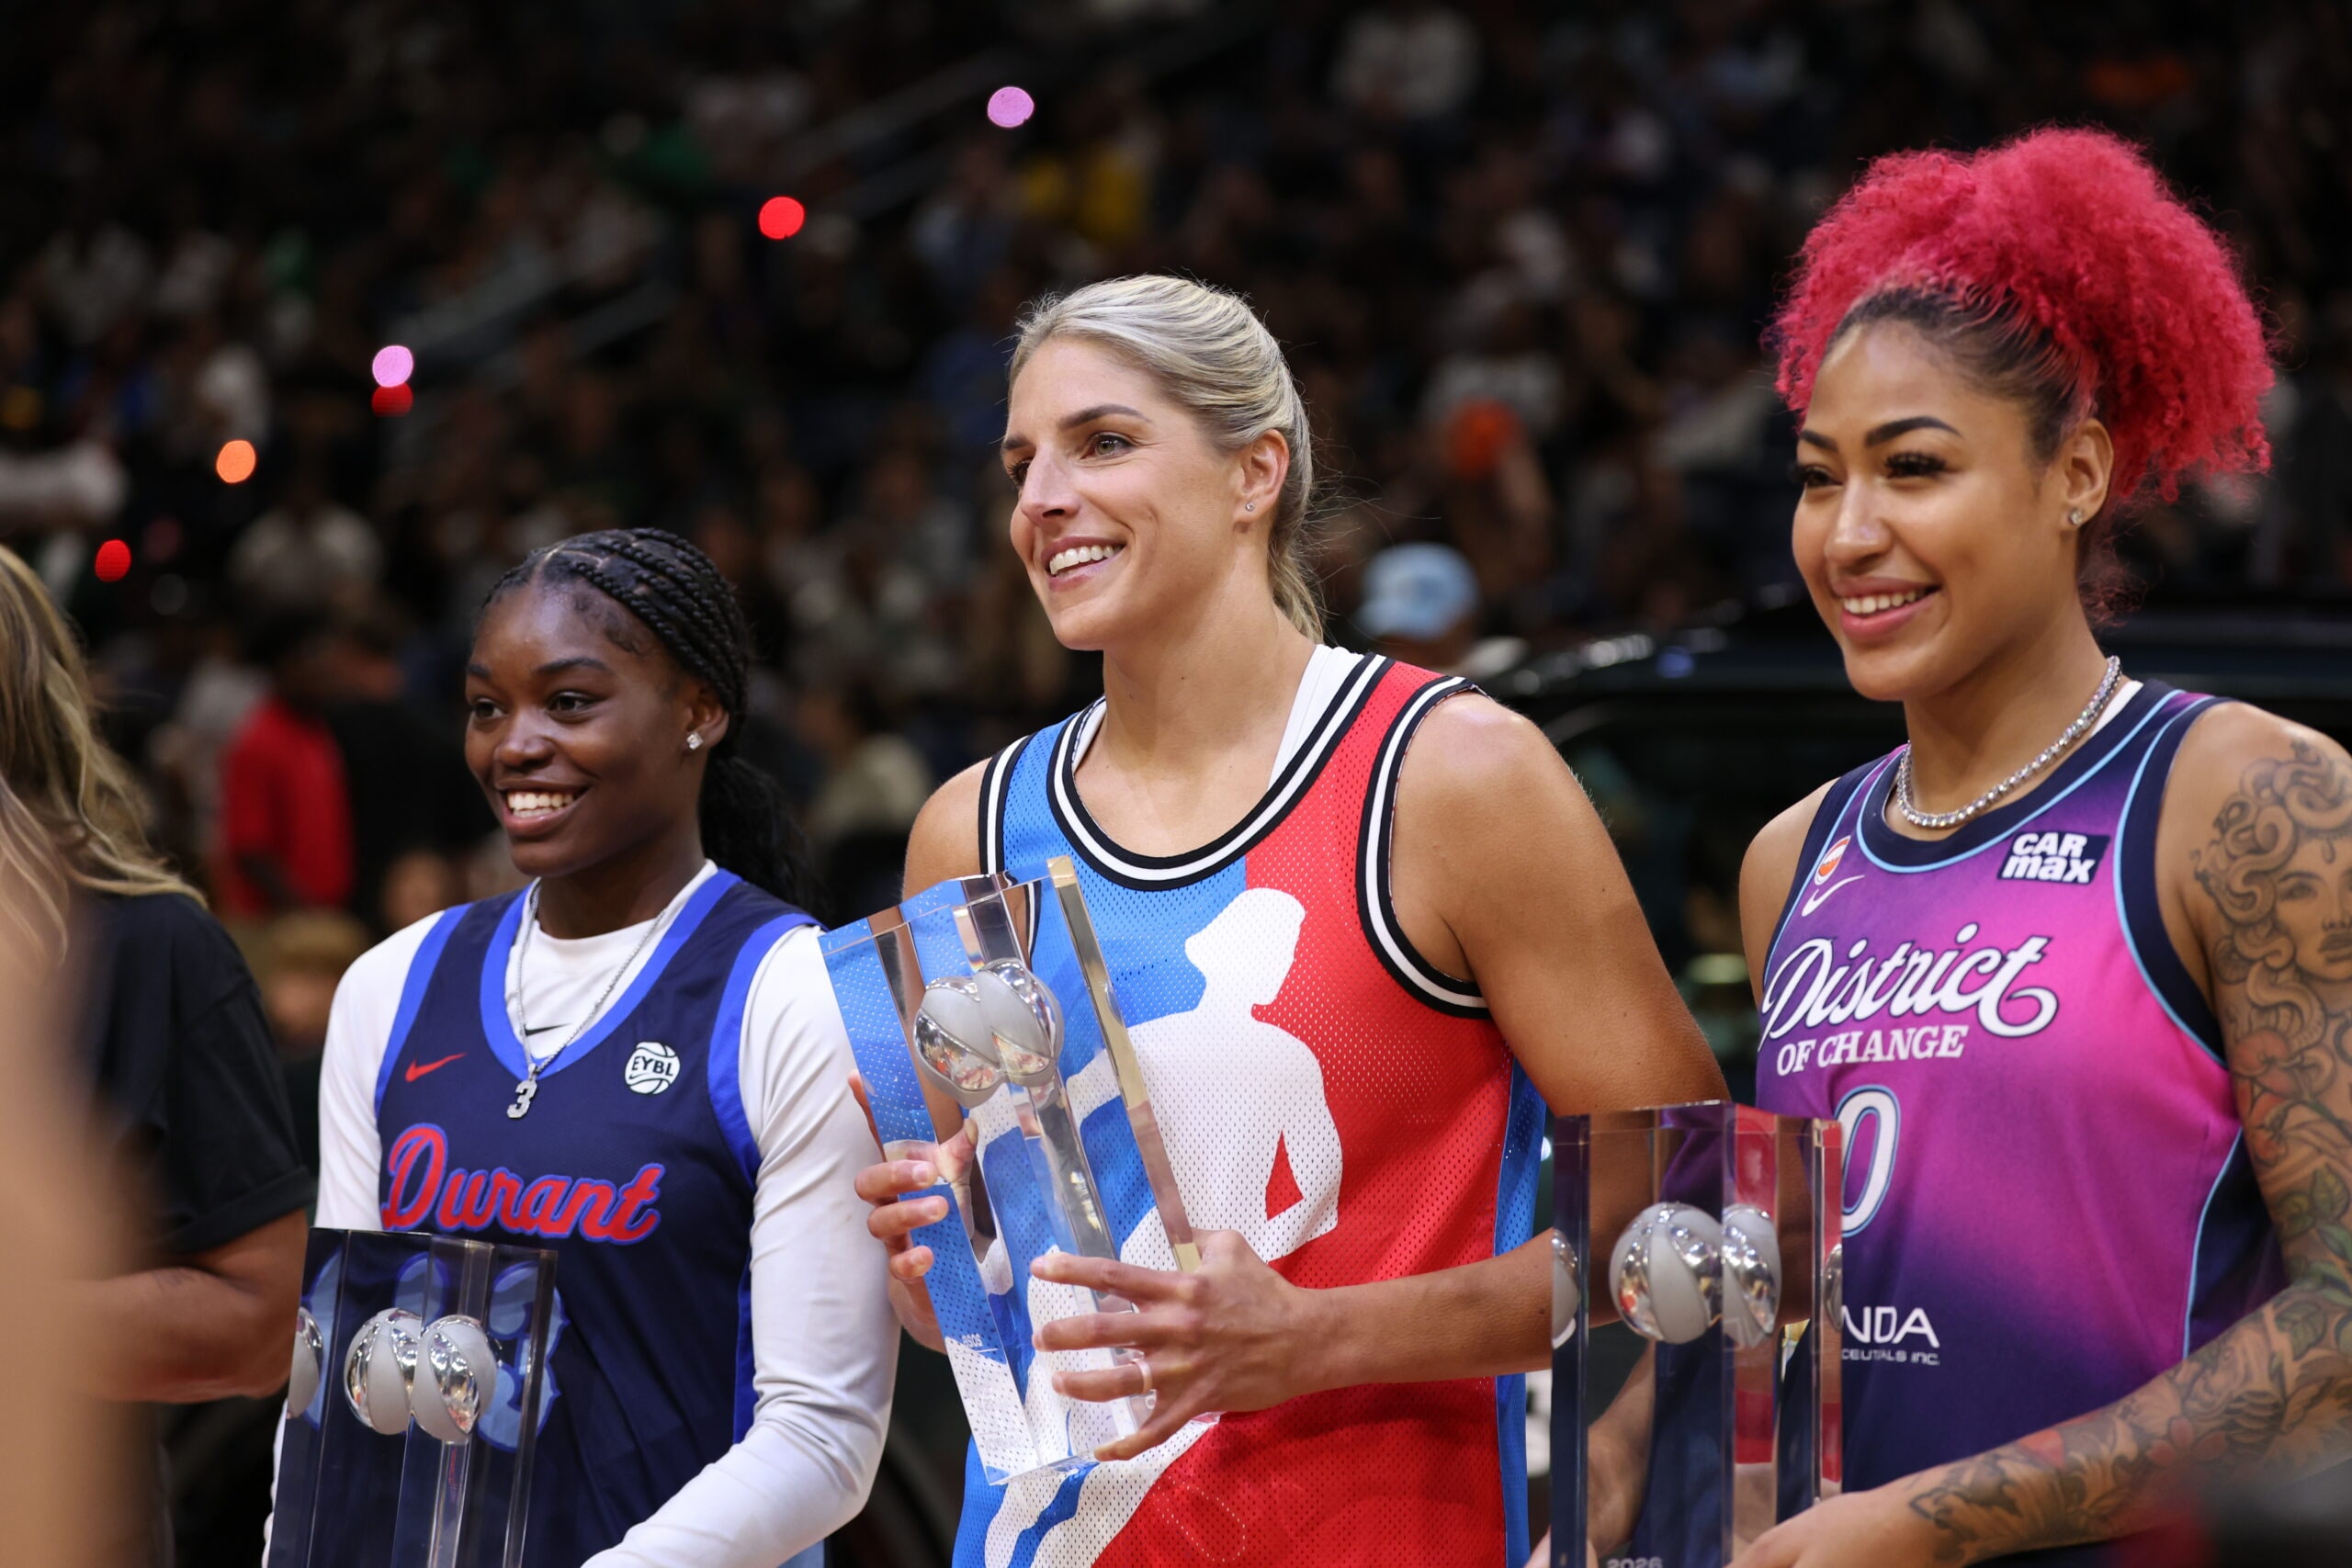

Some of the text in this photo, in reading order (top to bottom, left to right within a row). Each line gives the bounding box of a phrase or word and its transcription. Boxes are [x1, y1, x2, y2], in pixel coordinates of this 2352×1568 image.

[2012, 831, 2087, 858] CAR
[2001, 855, 2096, 884] max
[1758, 921, 2059, 1052] District
[632, 1055, 673, 1077] EYBL
[1776, 1025, 1969, 1077] OF CHANGE
[507, 1080, 537, 1118] 3
[381, 1122, 665, 1246] Durant
[1840, 1304, 1940, 1348] NDA
